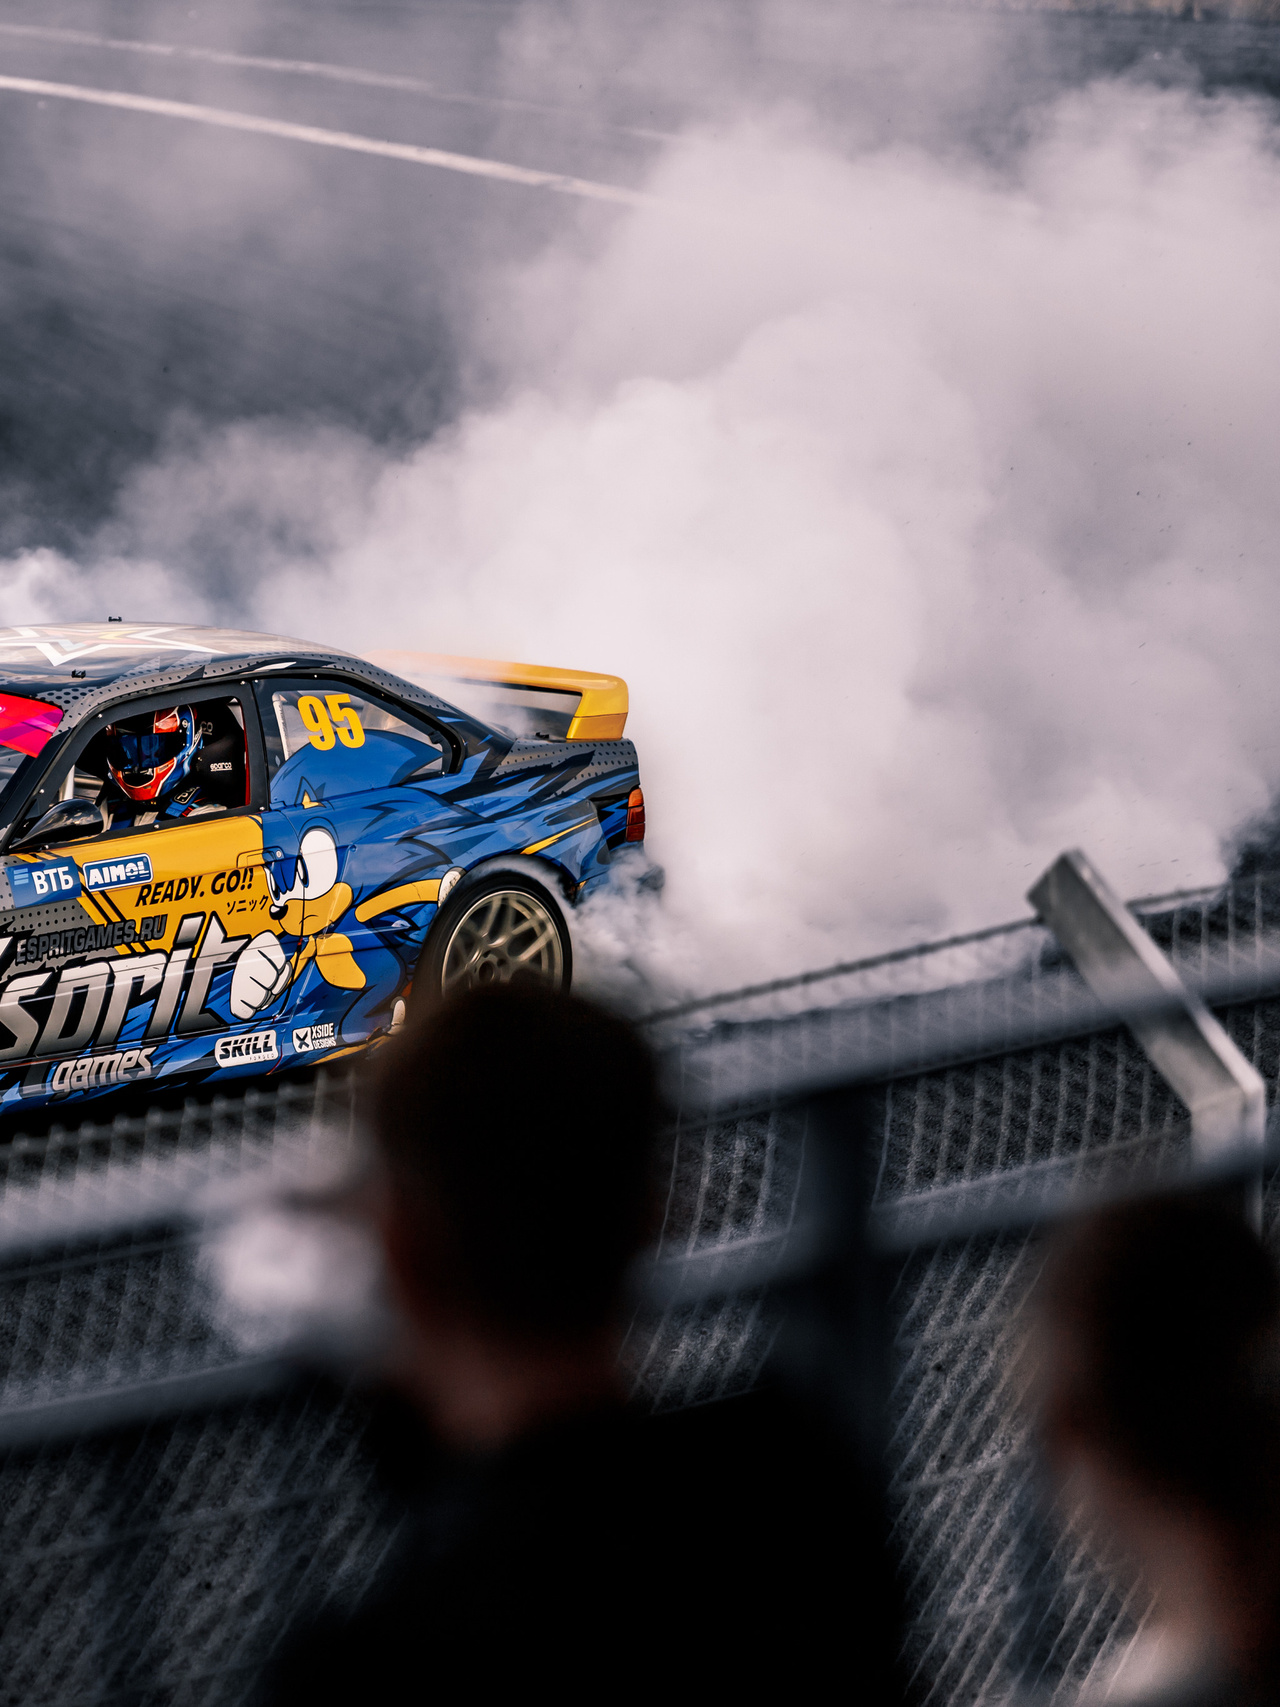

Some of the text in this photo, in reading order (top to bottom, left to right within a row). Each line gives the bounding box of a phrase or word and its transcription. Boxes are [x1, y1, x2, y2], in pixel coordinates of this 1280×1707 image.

[297, 693, 366, 751] 95
[31, 866, 74, 895] ВТБ
[88, 860, 150, 886] AIMOL
[134, 867, 254, 908] READY. GO!!
[226, 894, 269, 916] ソニック
[16, 915, 168, 964] ESPRITGAMES.RU
[311, 1023, 335, 1039] XSIDE
[219, 1034, 273, 1060] SKILL
[51, 1046, 157, 1099] games
